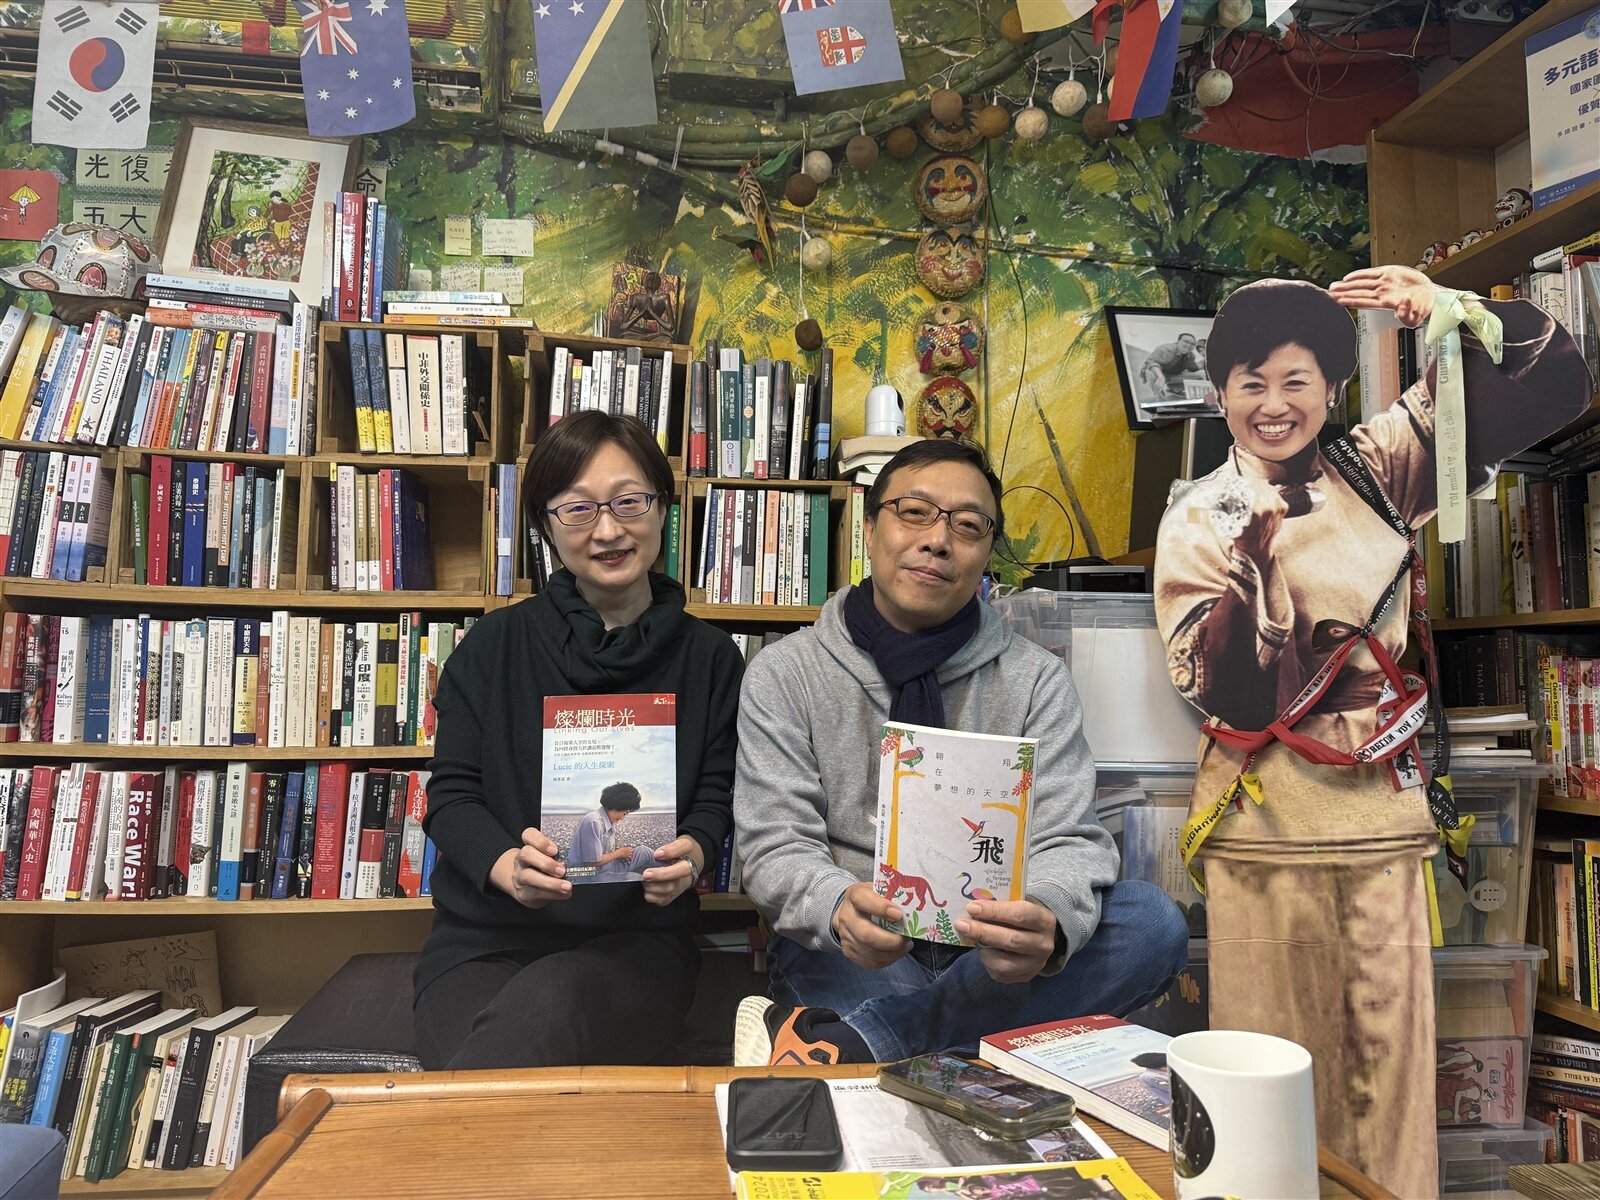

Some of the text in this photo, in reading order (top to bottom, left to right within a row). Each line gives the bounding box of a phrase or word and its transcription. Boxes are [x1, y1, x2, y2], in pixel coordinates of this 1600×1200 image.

[1544, 47, 1600, 86] 多元語
[82, 206, 147, 234] 五大
[91, 350, 115, 404] THAILAND
[418, 352, 431, 408] 中非外交關係史
[358, 664, 371, 682] 印度
[554, 708, 636, 729] 燦爛時光
[574, 761, 615, 770] 的人生探索
[935, 751, 1011, 767] 翱 翔
[935, 768, 943, 777] 在
[412, 788, 424, 819] 史達林
[934, 783, 1009, 798] 夢想的天空
[25, 807, 41, 864] 美國華人史
[121, 790, 145, 898] Race War!
[970, 836, 1004, 866] 飛
[754, 1176, 768, 1199] 2024
